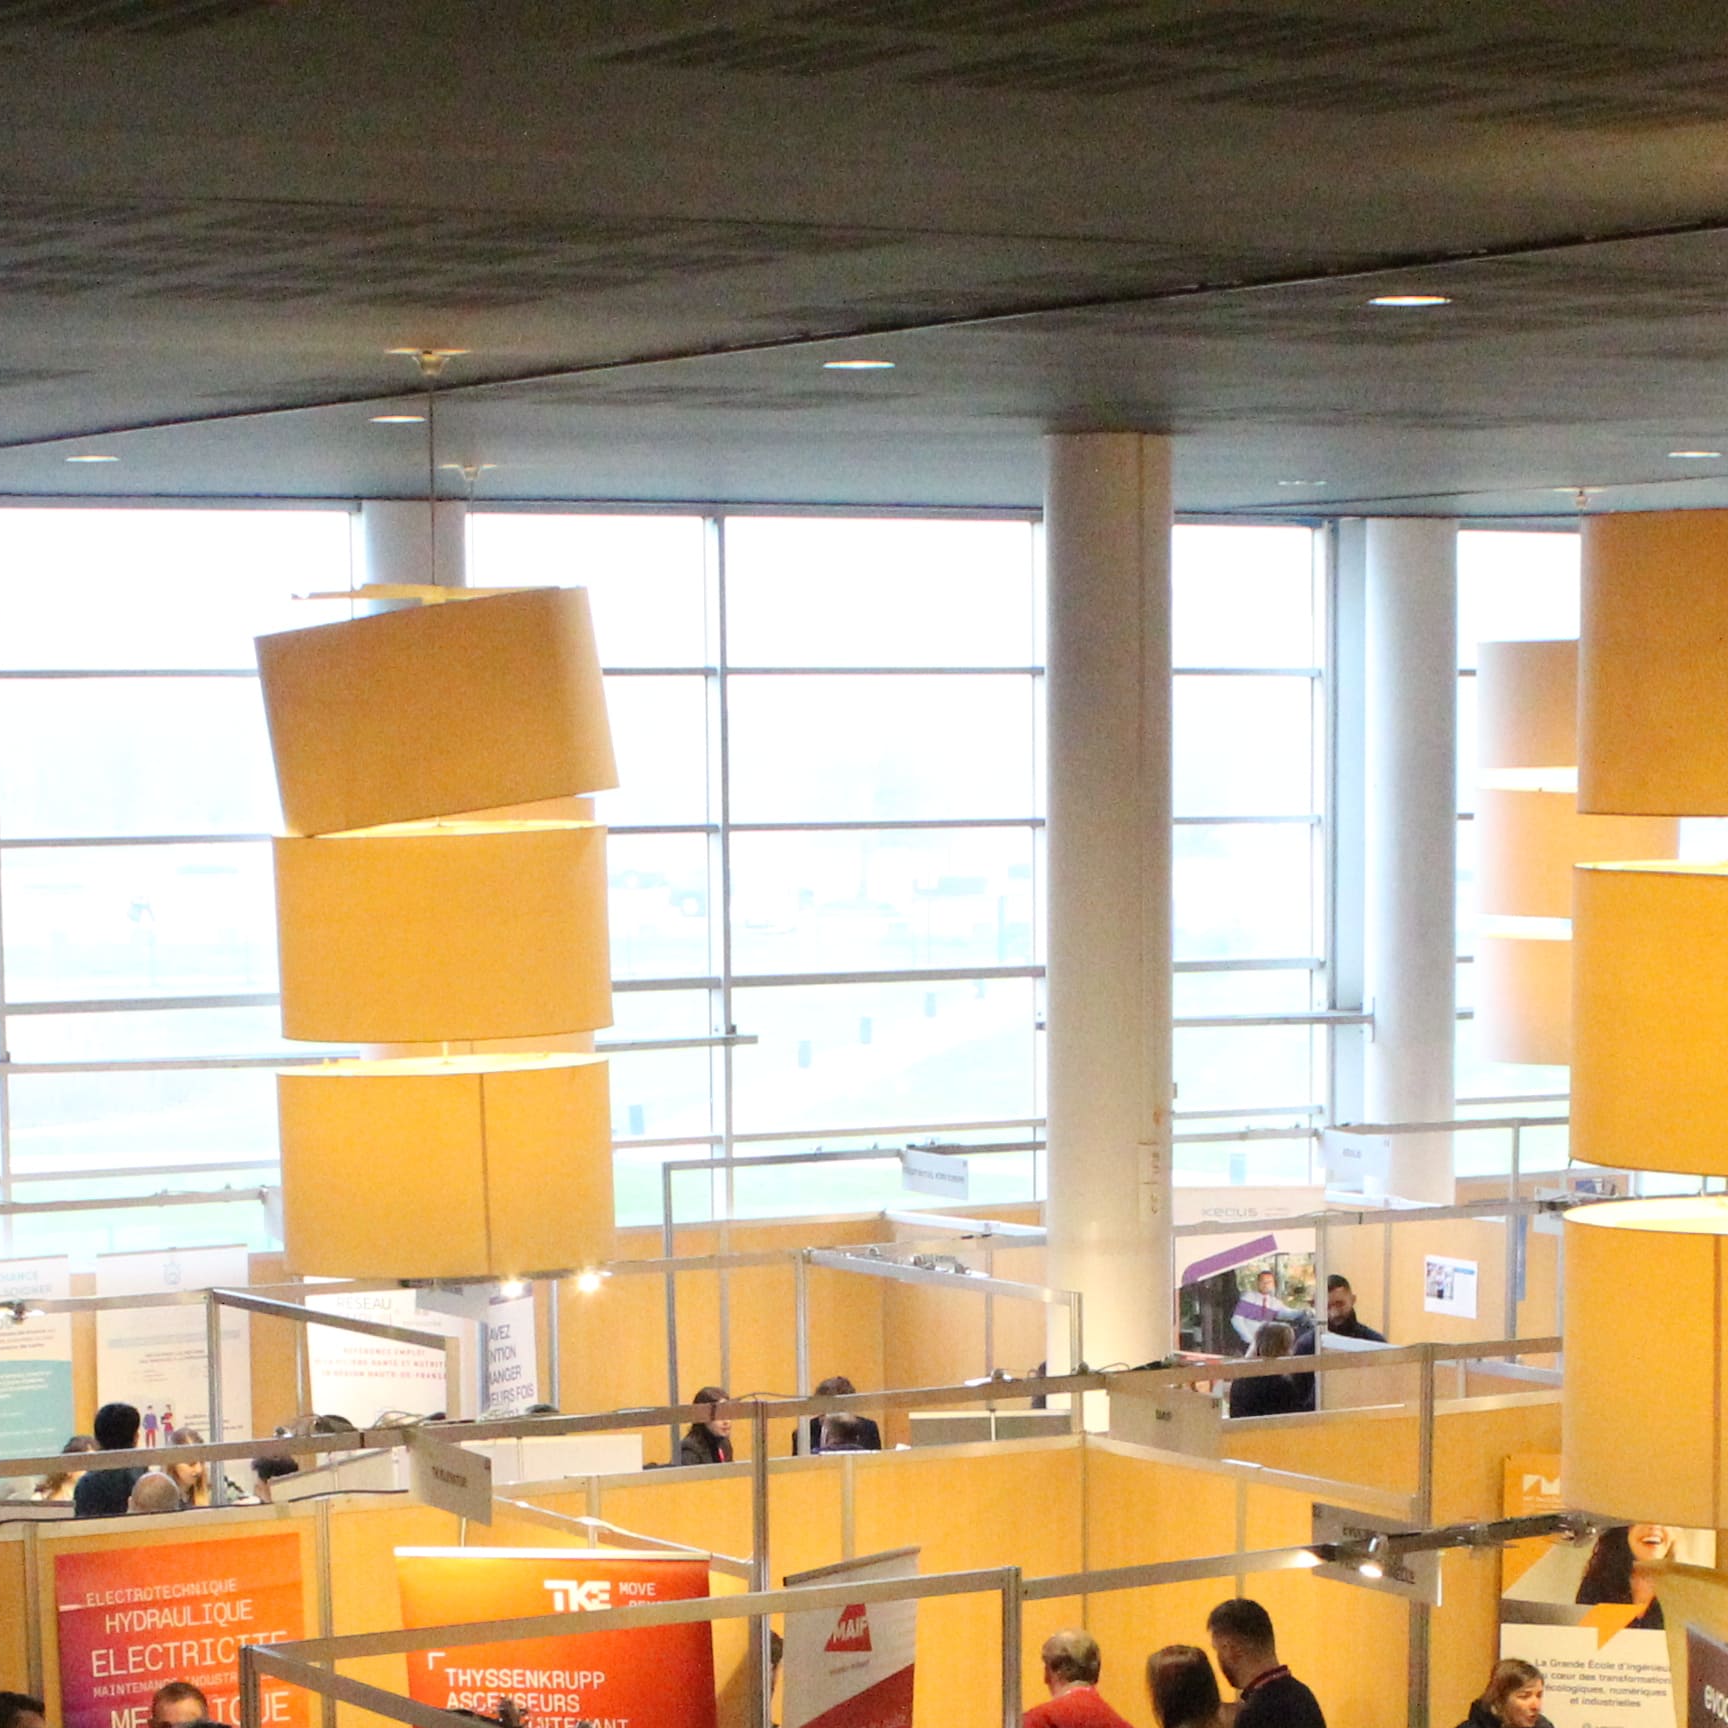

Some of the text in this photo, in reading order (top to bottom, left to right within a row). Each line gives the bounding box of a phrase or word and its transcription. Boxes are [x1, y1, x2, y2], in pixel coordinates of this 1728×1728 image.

[487, 1344, 518, 1367] NTION
[85, 1577, 238, 1608] ELECTROTECHNIQUE
[543, 1579, 657, 1613] TKE MOVE
[105, 1599, 254, 1635] HYDRAULIQUE
[1549, 1659, 1586, 1670] Grande
[444, 1667, 606, 1690] THYSSENKRUPP
[1578, 1672, 1597, 1682] des
[1599, 1673, 1672, 1685] transformation
[1569, 1696, 1642, 1708] et industrielles
